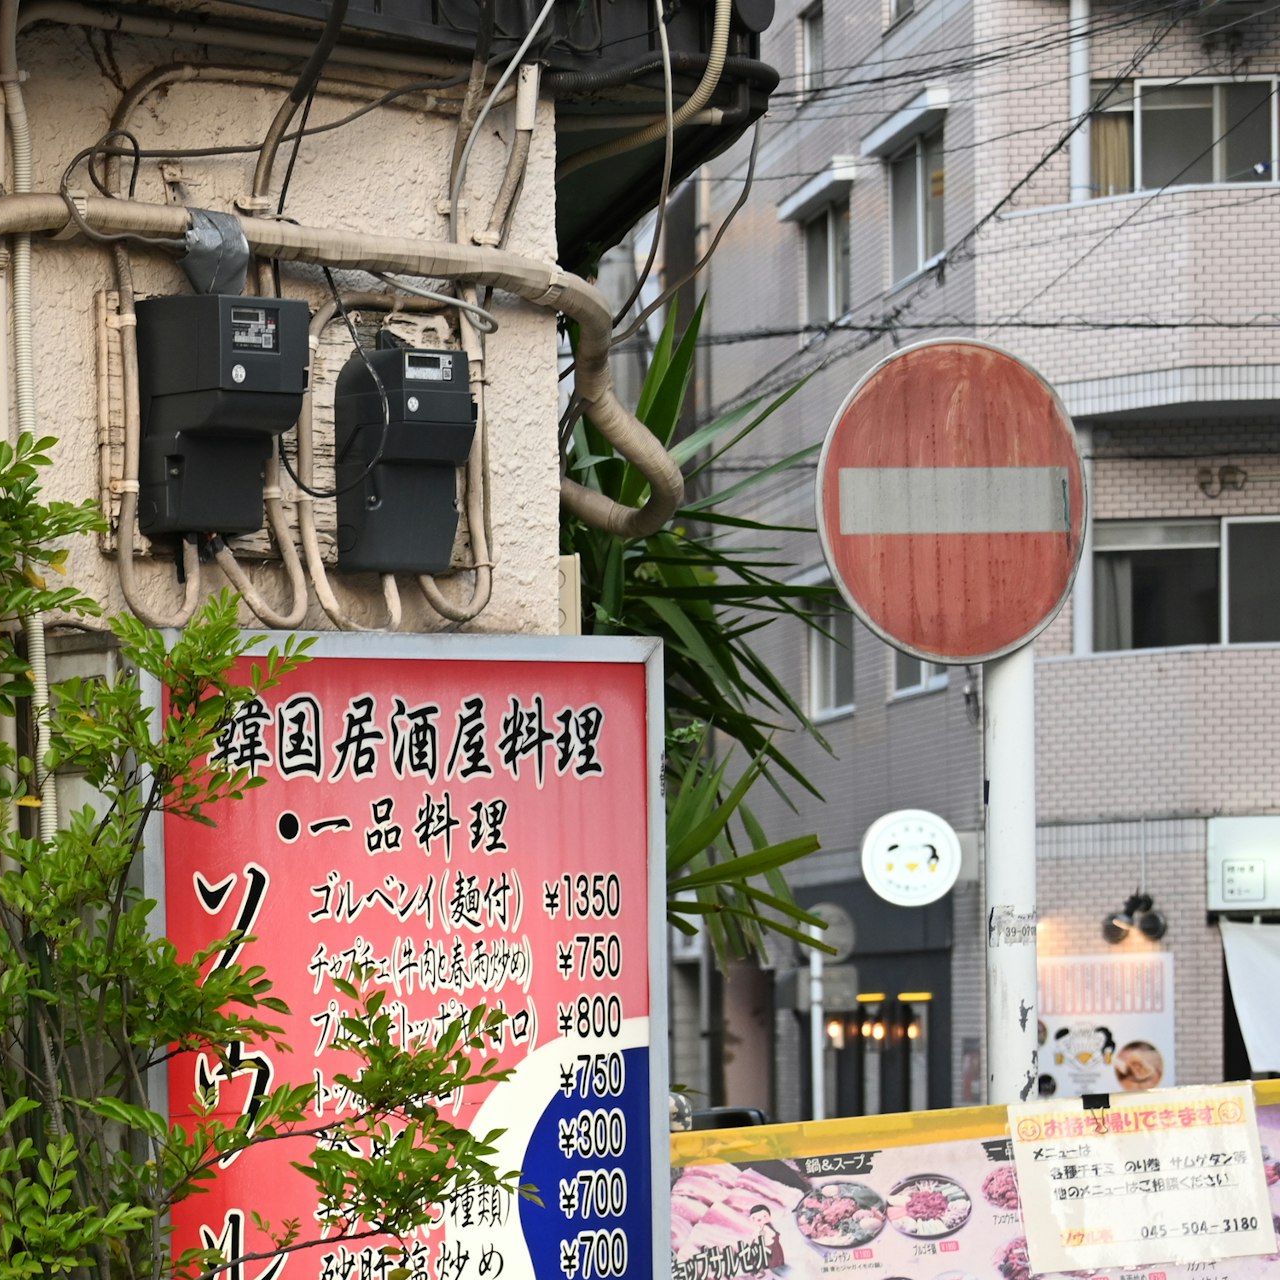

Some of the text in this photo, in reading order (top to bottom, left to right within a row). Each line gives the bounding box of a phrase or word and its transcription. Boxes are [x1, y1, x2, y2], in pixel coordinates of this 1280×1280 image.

[208, 696, 604, 786] 韓国居酒屋料理
[543, 873, 621, 921] ¥1350
[557, 934, 622, 981] ¥750
[557, 994, 622, 1039] ¥800
[558, 1050, 625, 1098] ¥750
[558, 1108, 627, 1159] ¥300
[1043, 1105, 1215, 1137] お持ち帰りできます
[805, 1153, 866, 1173] 鍋&スープ
[559, 1166, 628, 1219] ¥700
[1141, 1216, 1259, 1239] 045-504-3180
[560, 1227, 628, 1279] ¥700
